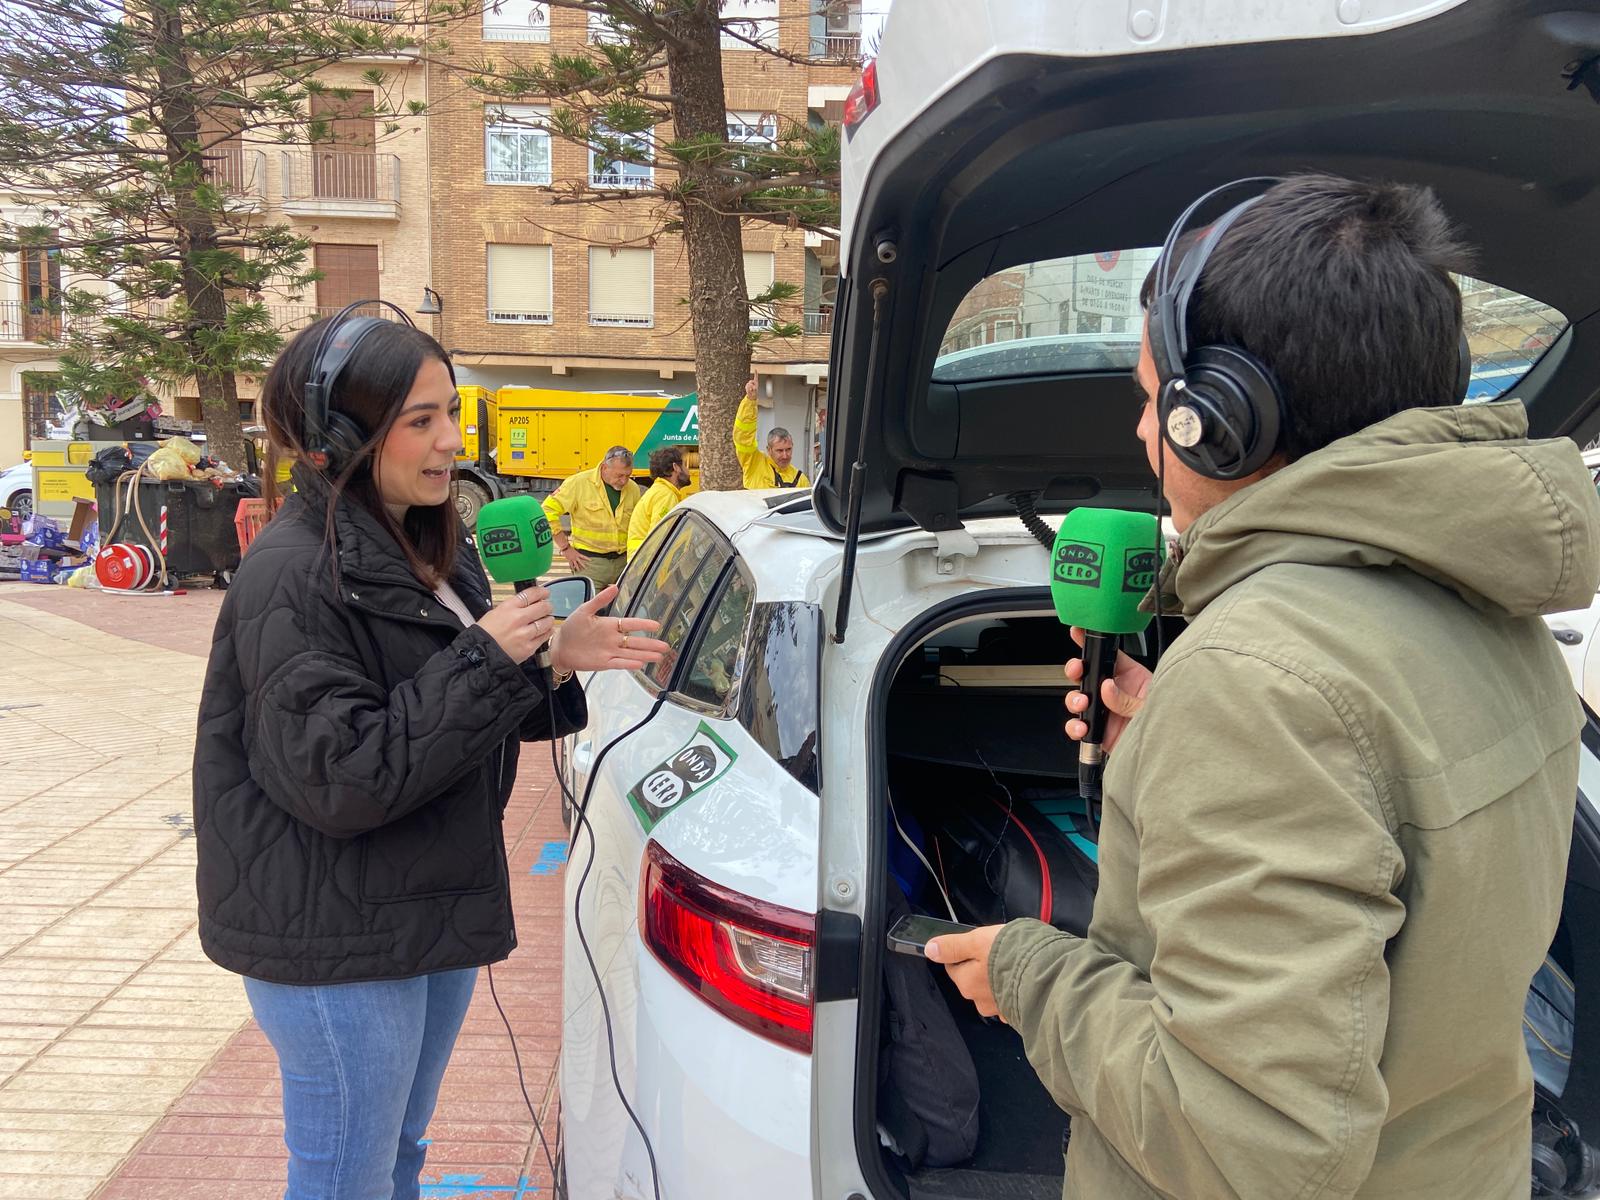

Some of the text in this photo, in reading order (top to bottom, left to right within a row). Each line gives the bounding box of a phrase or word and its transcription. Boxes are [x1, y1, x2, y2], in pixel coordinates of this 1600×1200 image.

[509, 416, 530, 425] AP205
[485, 532, 512, 540] ONDA
[489, 542, 515, 552] CERO
[1060, 548, 1094, 560] ONDA
[1060, 564, 1092, 578] CERO
[679, 749, 711, 780] ONDA
[648, 773, 678, 804] CERO
